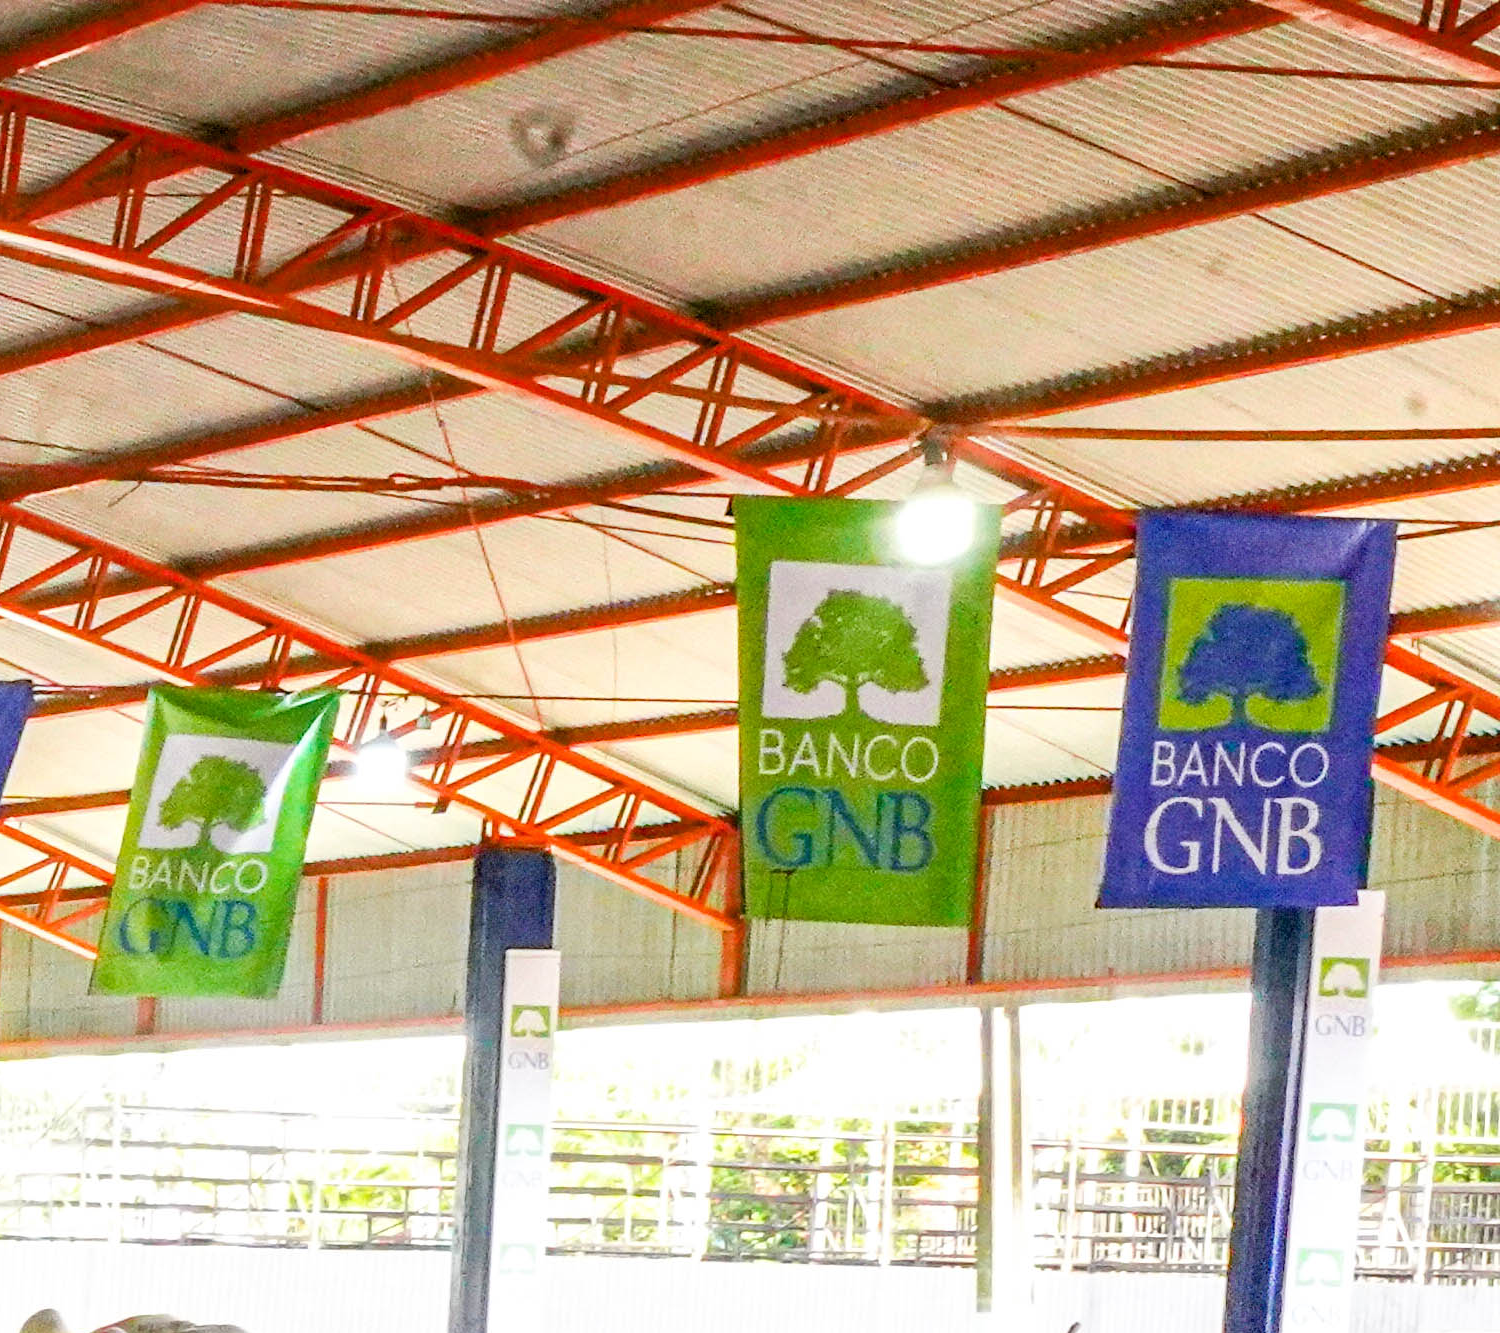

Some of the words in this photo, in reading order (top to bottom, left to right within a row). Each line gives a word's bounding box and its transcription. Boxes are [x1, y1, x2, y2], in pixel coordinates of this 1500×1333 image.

[758, 729, 939, 783] BANCO
[1151, 740, 1330, 788] BANCO
[756, 786, 935, 871] GNB
[1143, 796, 1323, 876] GNB
[128, 855, 268, 895] BANCO
[119, 898, 257, 959] GNB
[1315, 1014, 1367, 1037] GNB
[508, 1052, 549, 1071] GNB
